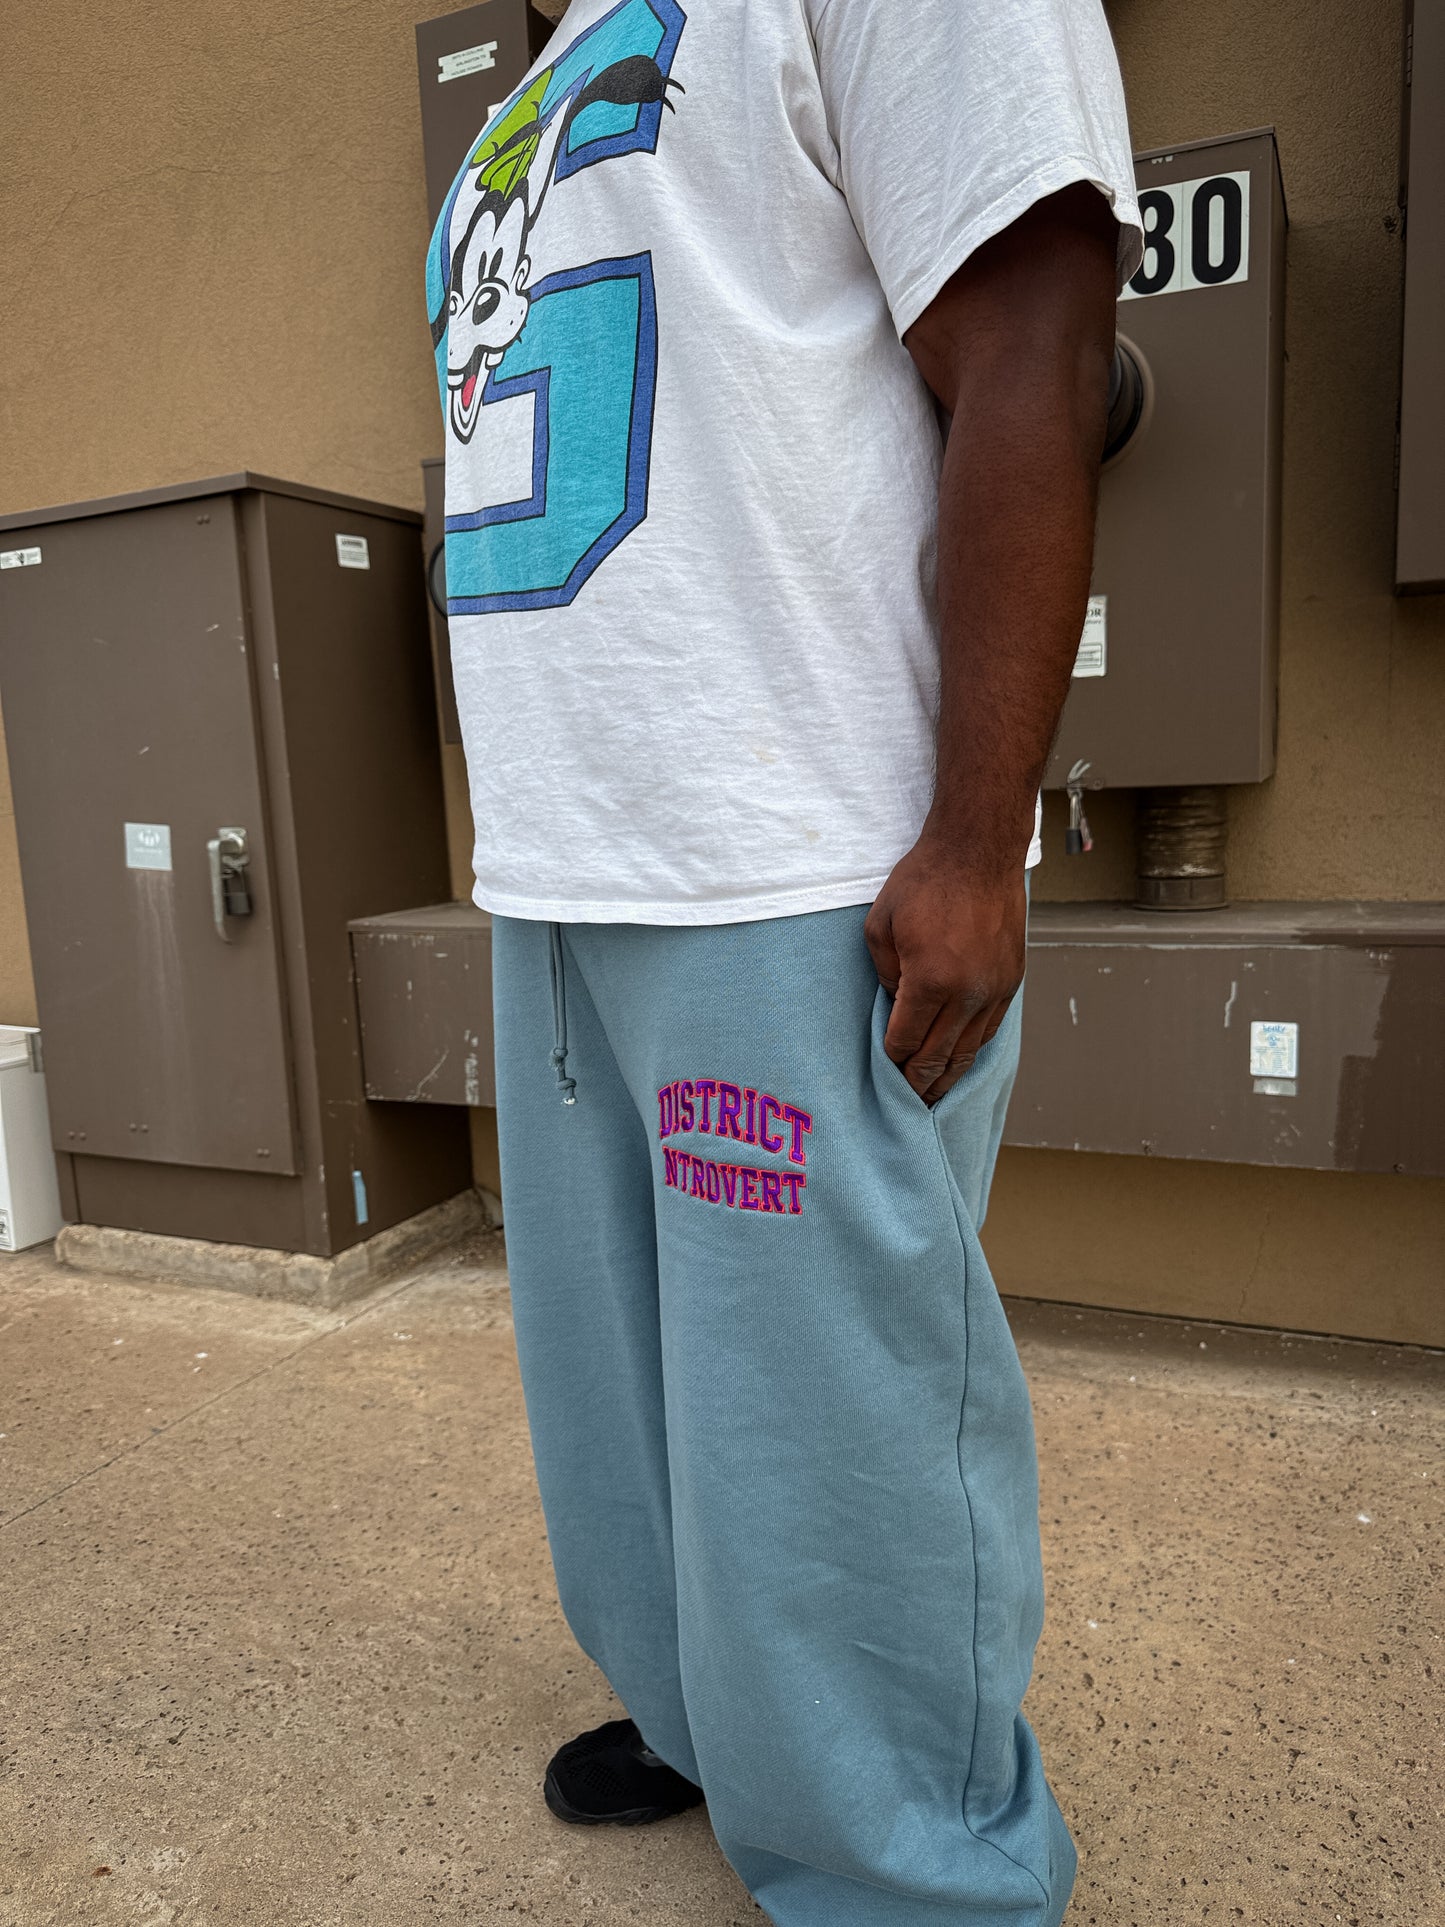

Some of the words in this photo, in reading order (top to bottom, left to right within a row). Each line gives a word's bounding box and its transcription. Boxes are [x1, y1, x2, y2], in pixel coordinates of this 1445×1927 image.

[1129, 177, 1242, 295] 80
[657, 1078, 813, 1166] DISTRICT
[662, 1145, 806, 1215] NTROVERT
